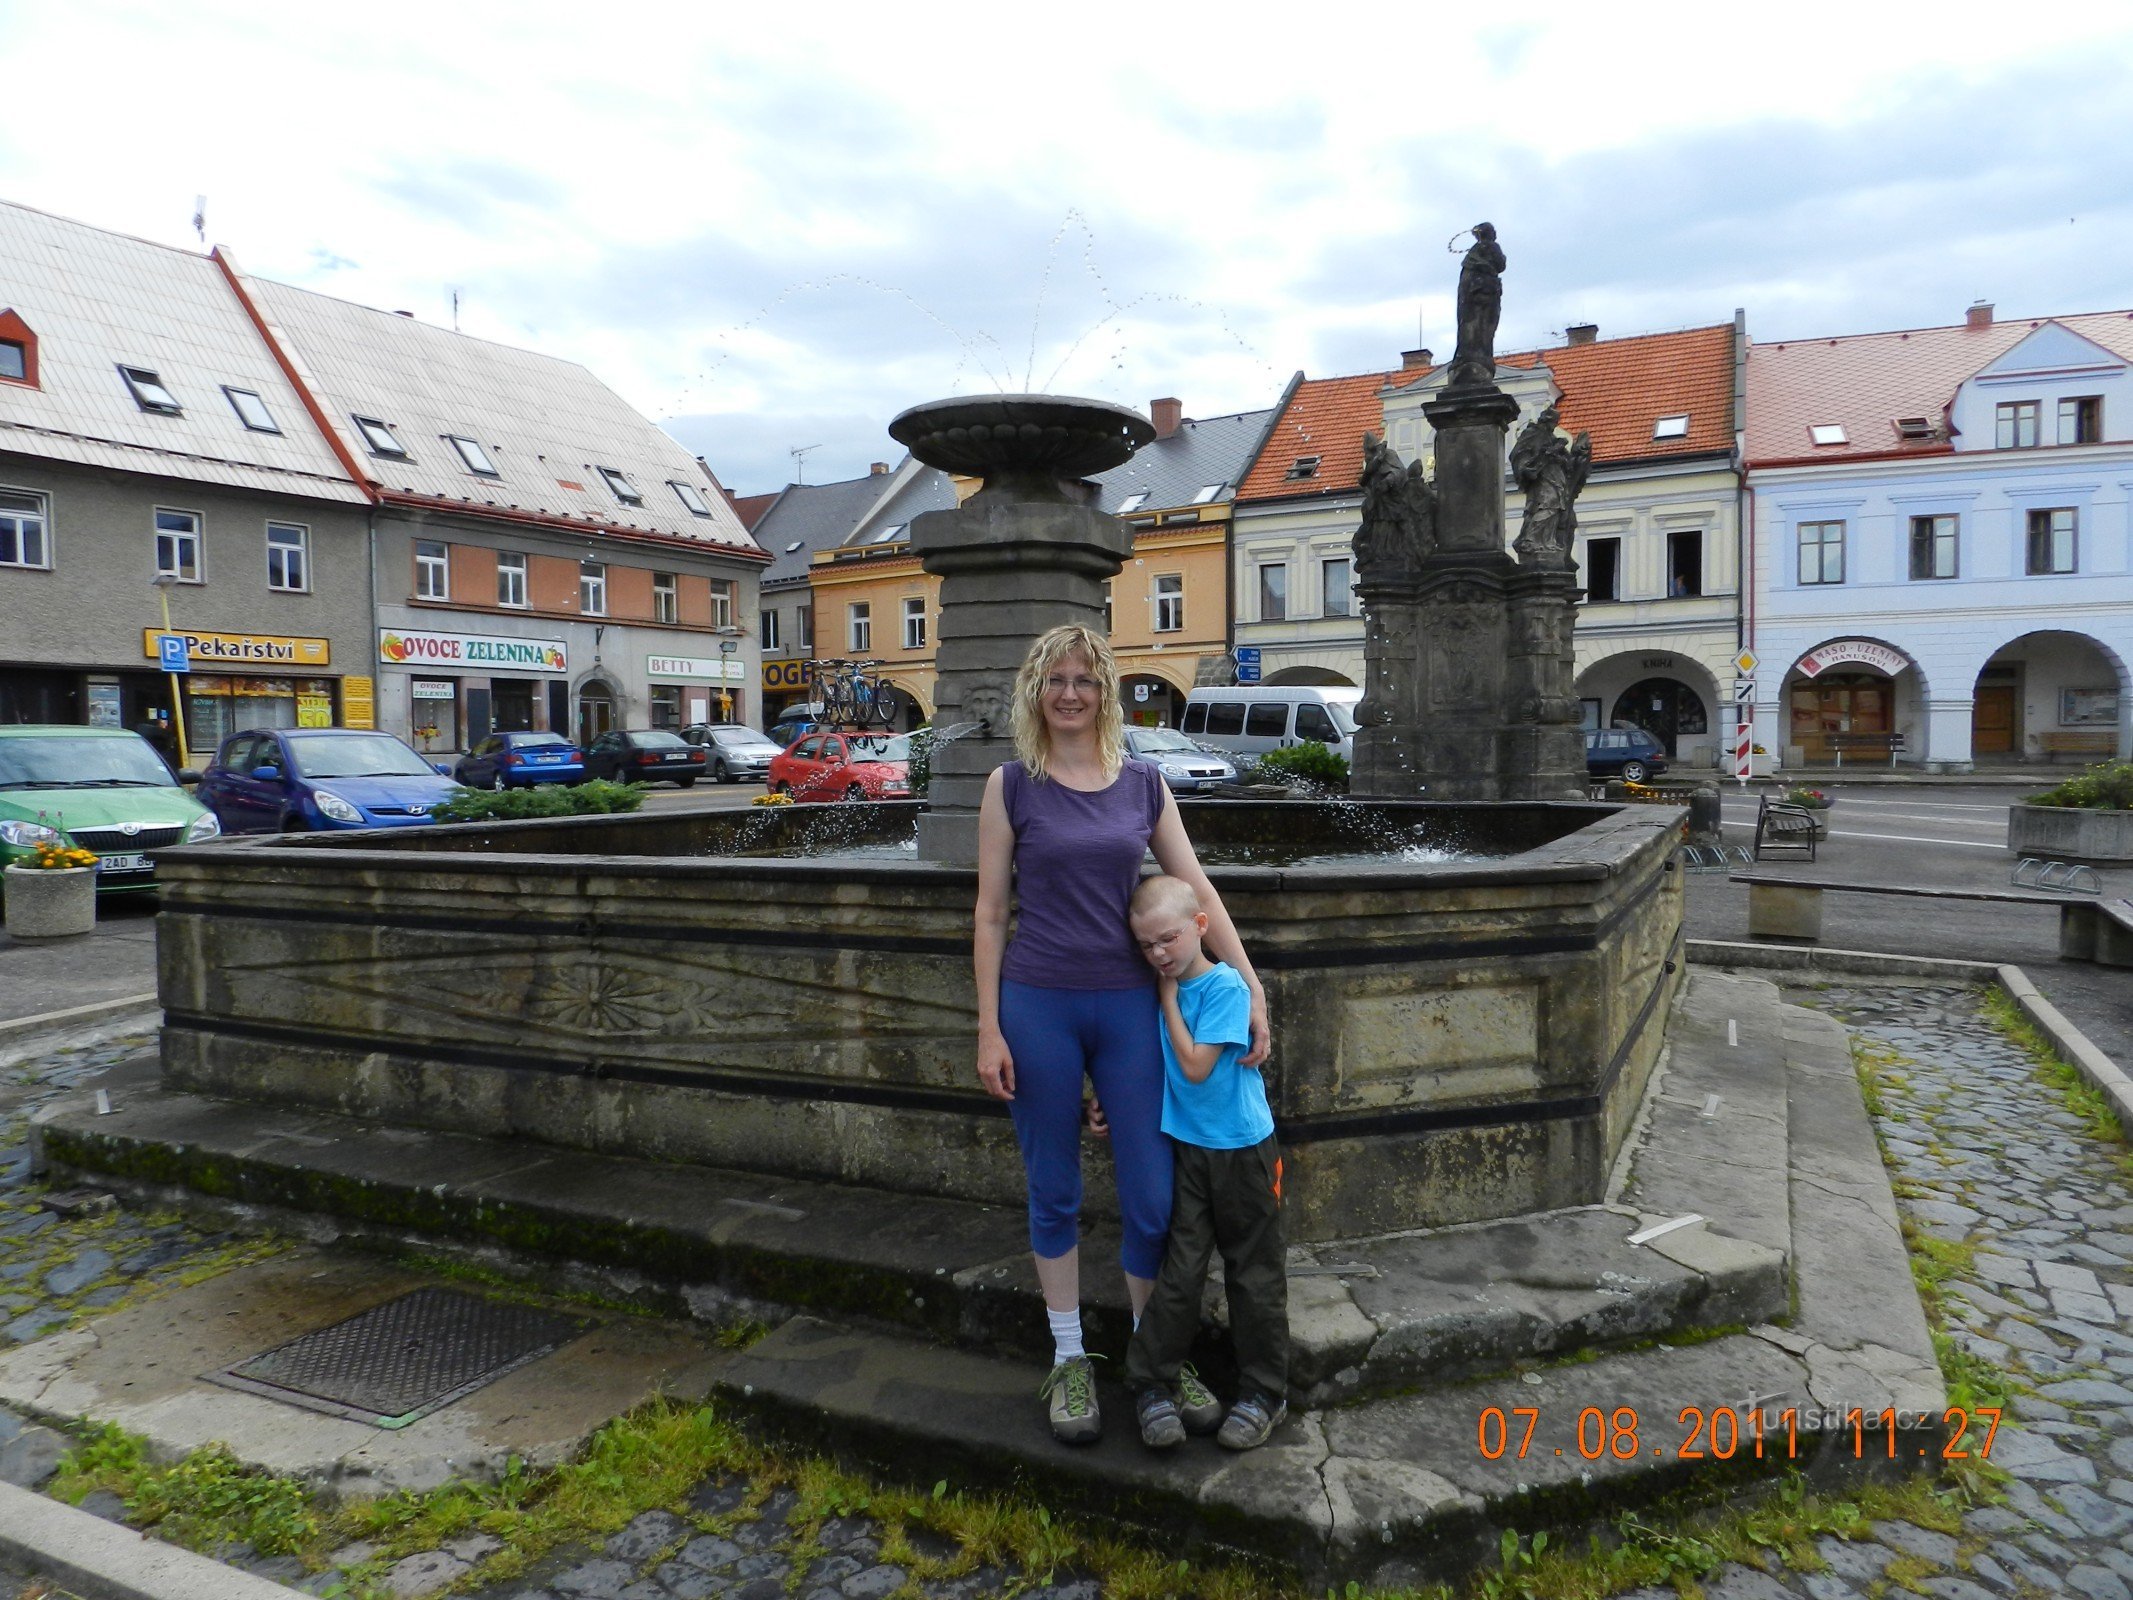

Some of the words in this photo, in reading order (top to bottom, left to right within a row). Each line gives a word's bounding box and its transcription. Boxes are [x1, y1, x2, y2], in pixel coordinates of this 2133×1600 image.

[164, 639, 181, 661] P
[185, 634, 295, 660] Pekařství
[404, 636, 461, 659] OVOCE
[466, 641, 546, 664] ZELENINA
[1815, 644, 1847, 659] MASO
[1857, 643, 1905, 667] UZENINY
[651, 658, 694, 673] BETTY
[420, 682, 447, 690] OVOCE
[105, 857, 128, 869] 2AD
